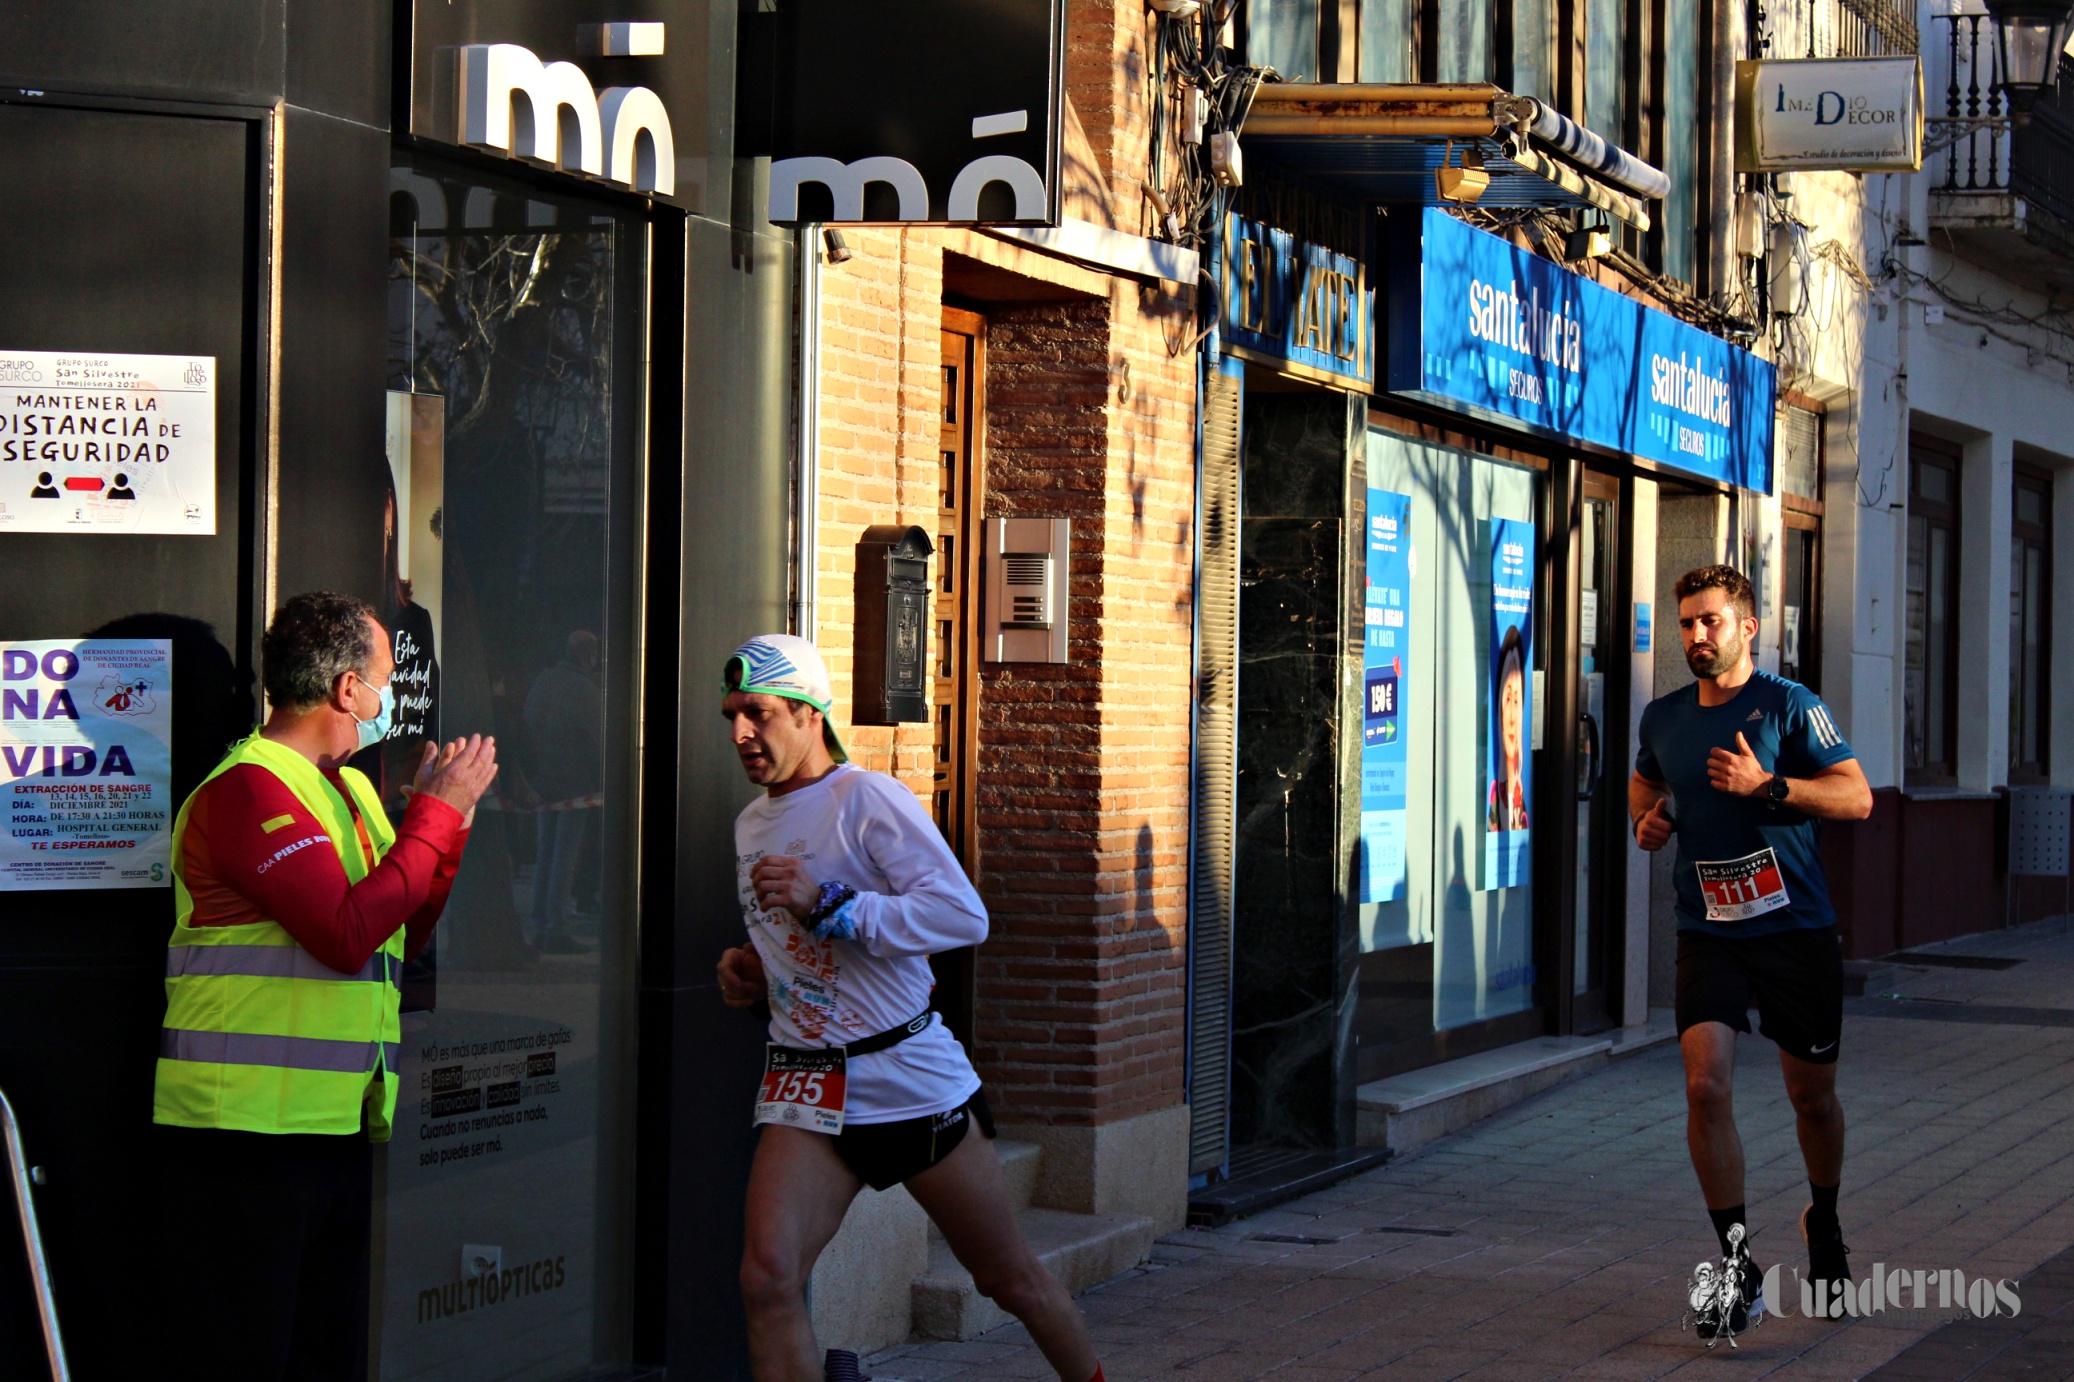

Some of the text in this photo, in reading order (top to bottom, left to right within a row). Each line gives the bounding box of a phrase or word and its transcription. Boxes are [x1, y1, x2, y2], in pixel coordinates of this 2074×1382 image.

[1469, 279, 1580, 373] santalucía
[56, 368, 139, 379] San Silvestre
[57, 359, 81, 367] GRUPO
[56, 380, 113, 388] Tomellosera
[1509, 367, 1543, 406] SEGUROS
[1651, 351, 1731, 428] santalucía
[17, 395, 157, 411] MANTENER LA
[159, 424, 181, 438] DE
[1679, 425, 1705, 457] SEGUROS
[3, 440, 170, 462] SEGURIDAD
[2, 649, 79, 681] DO
[3, 689, 80, 720] NA
[400, 686, 432, 721] puede
[1, 745, 136, 777] VIDA
[15, 783, 86, 793] EXTRACCIÓN
[108, 784, 152, 792] SANGRE
[65, 793, 77, 801] 14,
[80, 793, 92, 801] 15,
[134, 793, 139, 802] y
[12, 799, 128, 809] DÍA: DICIEMBRE 2021
[12, 815, 47, 823] HORA:
[103, 812, 126, 820] 21:30
[129, 811, 165, 819] HORAS
[12, 823, 162, 837] LUGAR: HOSPITAL GENERAL
[31, 840, 136, 850] TE ESPERAMOS
[257, 859, 276, 873] CAA
[273, 838, 313, 861] PIELES
[1702, 858, 1768, 876] San Silvestre
[1719, 877, 1760, 904] 111
[793, 976, 826, 994] Pieles
[440, 1050, 449, 1060] es
[472, 1044, 488, 1059] que
[490, 1042, 506, 1054] una
[507, 1035, 534, 1052] marca
[535, 1030, 547, 1047] de
[421, 1072, 431, 1089] Es
[432, 1067, 462, 1088] diseño
[464, 1064, 491, 1084] propio
[493, 1060, 501, 1079] al
[502, 1057, 527, 1079] mejor
[420, 1098, 431, 1115] Es
[432, 1090, 480, 1114] innovación
[481, 1093, 487, 1109] y
[488, 1084, 520, 1105] calidad
[521, 1083, 532, 1098] sin
[773, 1072, 826, 1105] 155
[420, 1104, 548, 1140] Cuando no renuncias a nada,
[931, 1112, 965, 1134] VIATOR
[419, 1146, 439, 1167] solo
[440, 1141, 469, 1167] puede
[471, 1141, 485, 1156] ser
